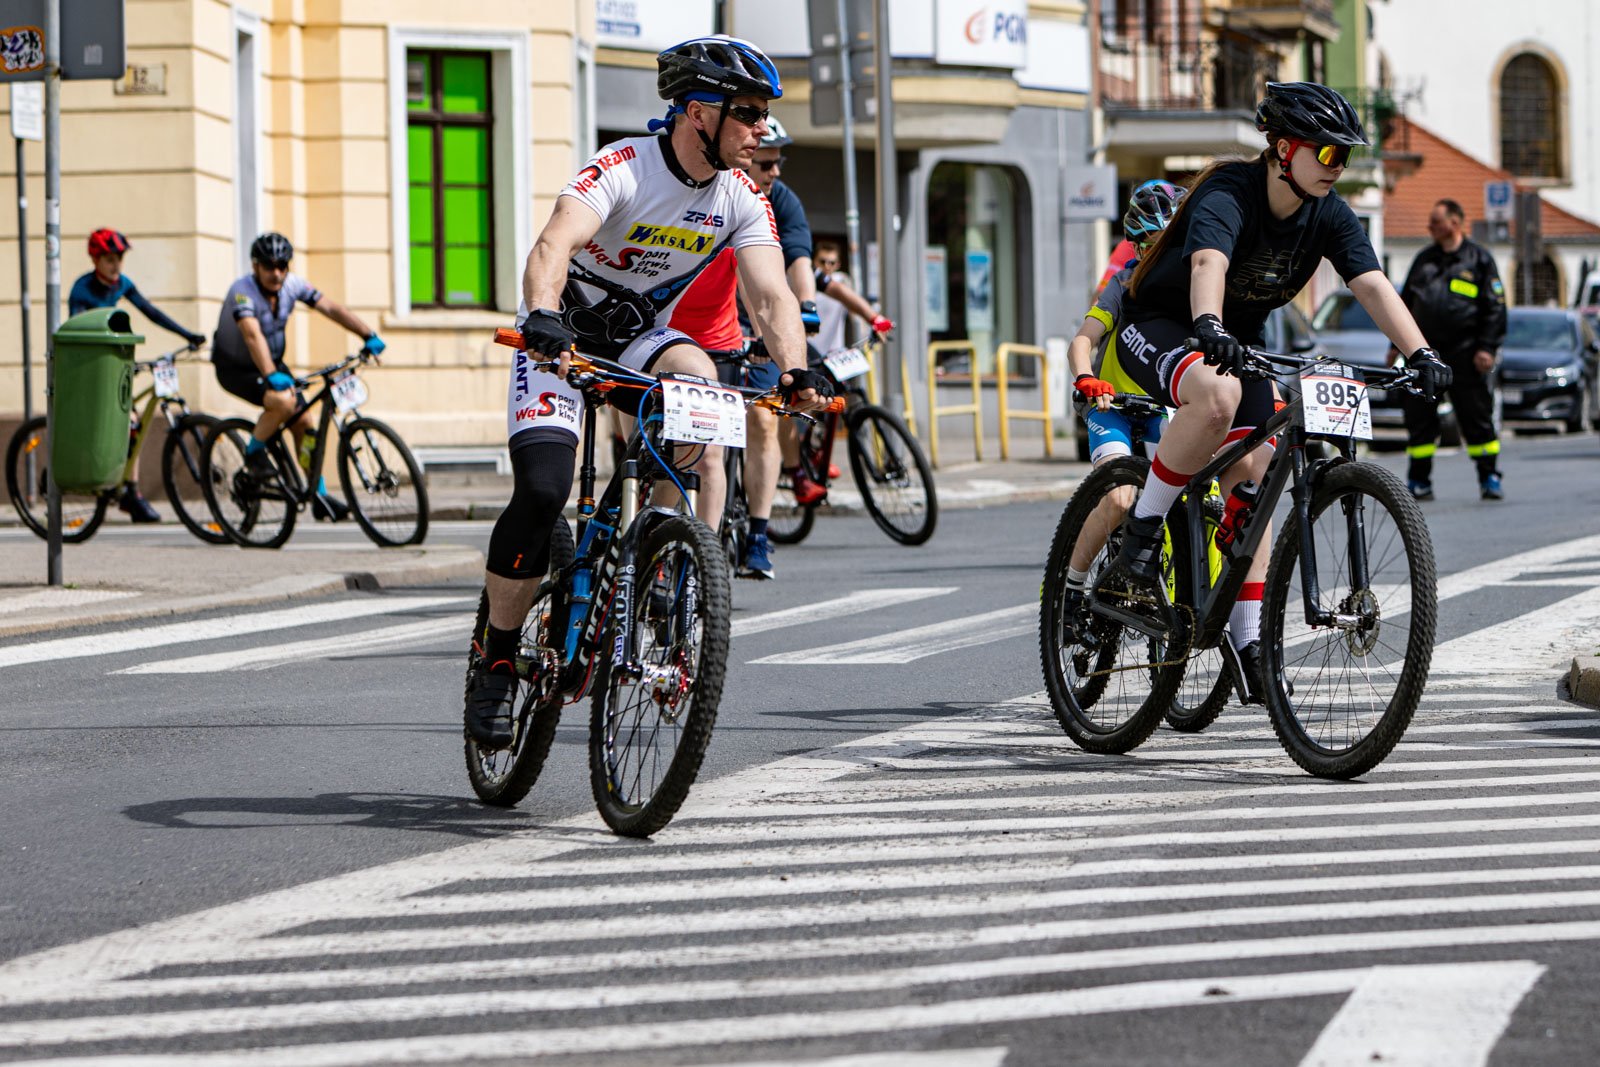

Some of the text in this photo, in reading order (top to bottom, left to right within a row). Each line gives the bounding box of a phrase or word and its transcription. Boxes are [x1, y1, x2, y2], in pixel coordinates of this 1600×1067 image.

[683, 210, 724, 228] ZPAS
[1120, 323, 1158, 365] BMC
[516, 350, 529, 395] ANT
[1316, 381, 1359, 408] 895
